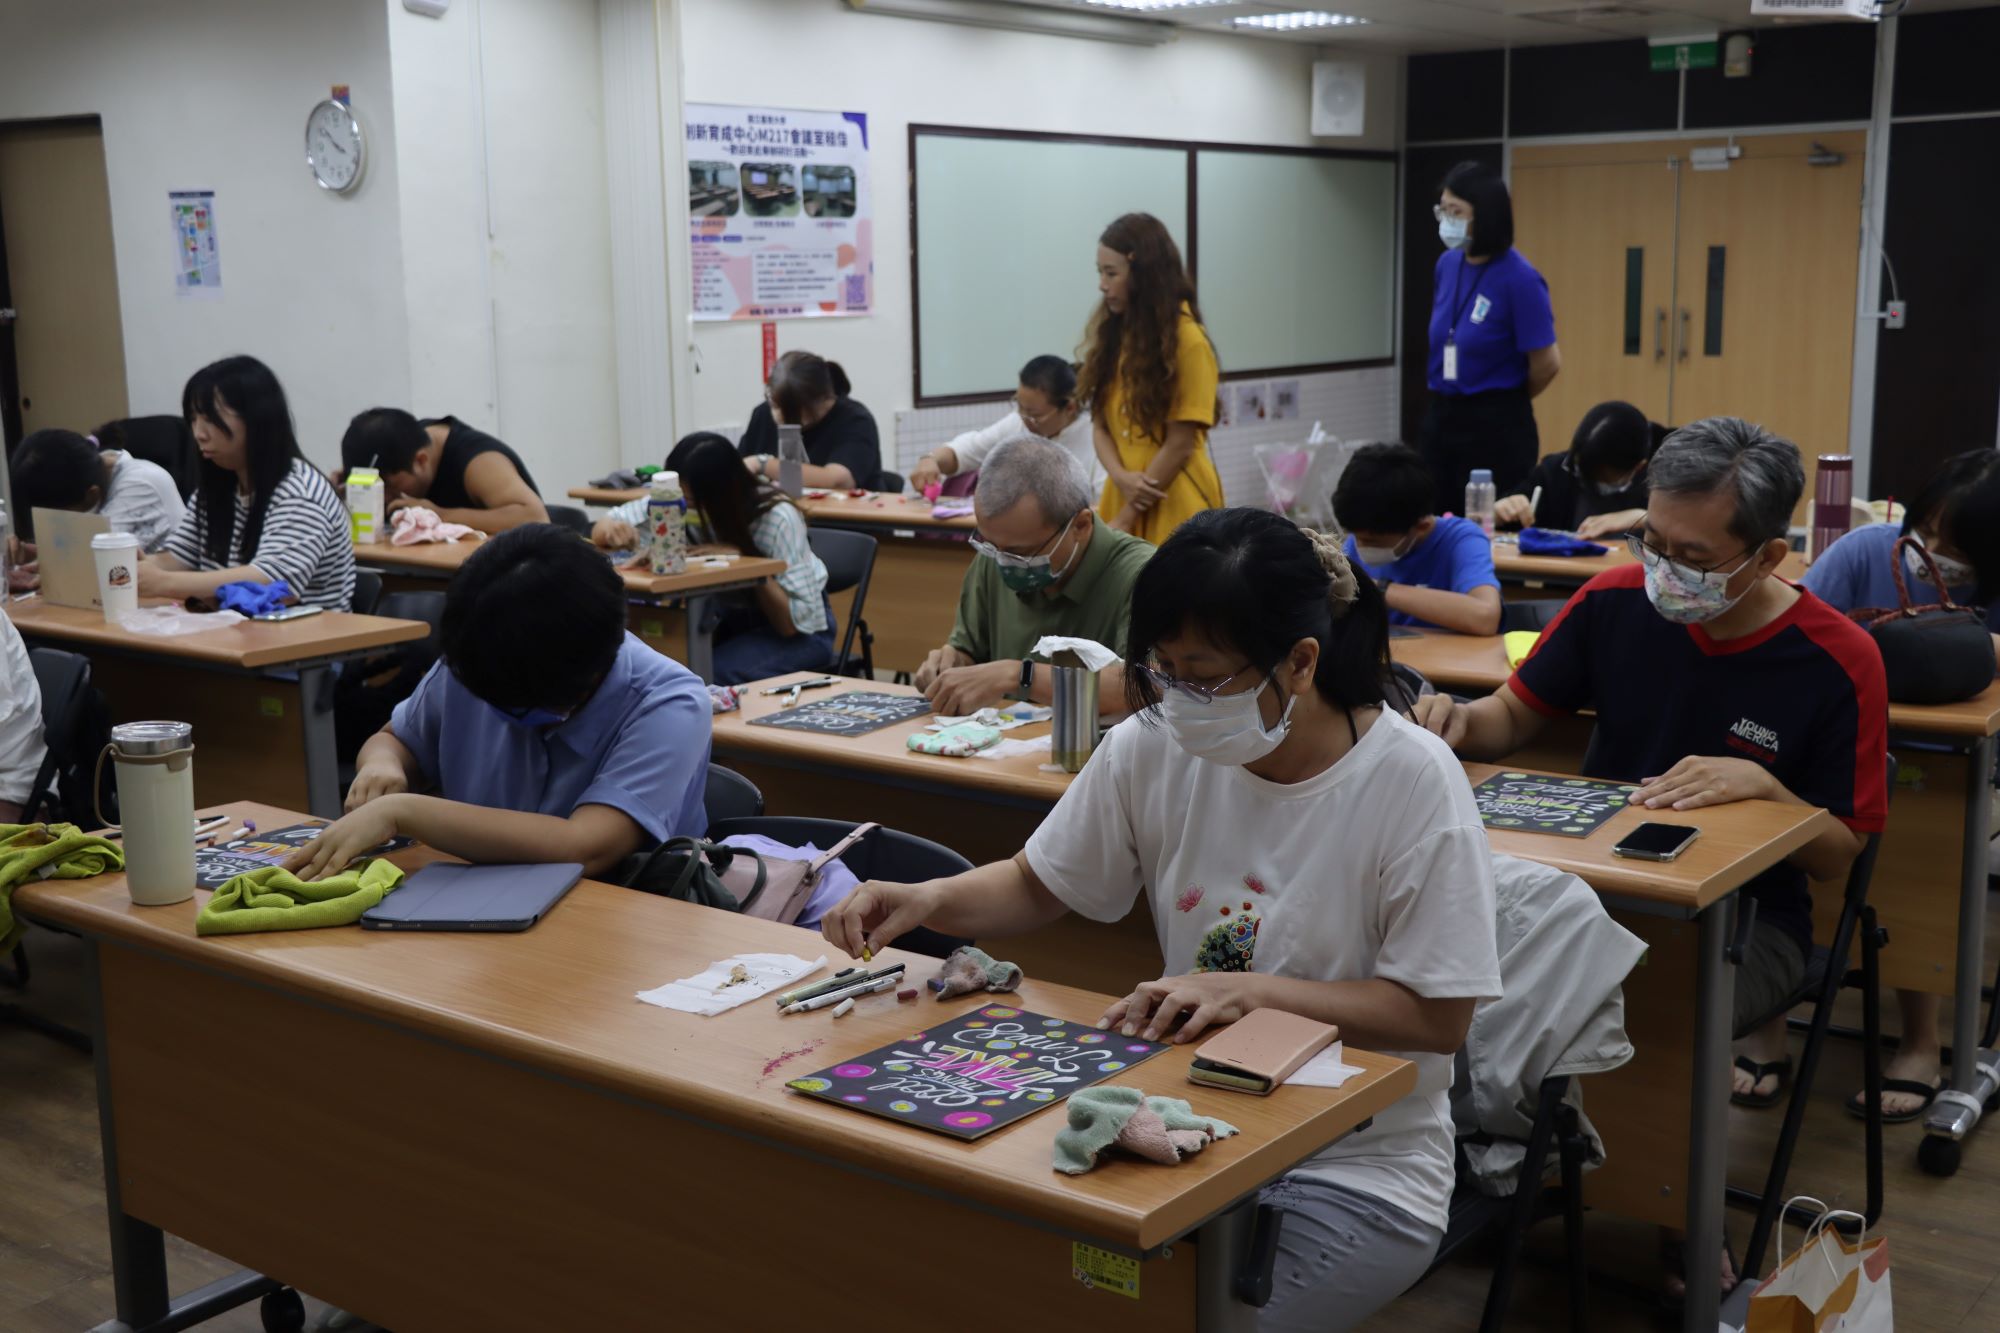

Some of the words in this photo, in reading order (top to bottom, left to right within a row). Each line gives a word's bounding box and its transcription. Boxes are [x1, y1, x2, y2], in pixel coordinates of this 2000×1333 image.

[1729, 722, 1779, 752] AMERICA
[1740, 717, 1777, 741] YOUNG
[913, 1068, 981, 1091] THINGS
[914, 1045, 1058, 1092] TAKE
